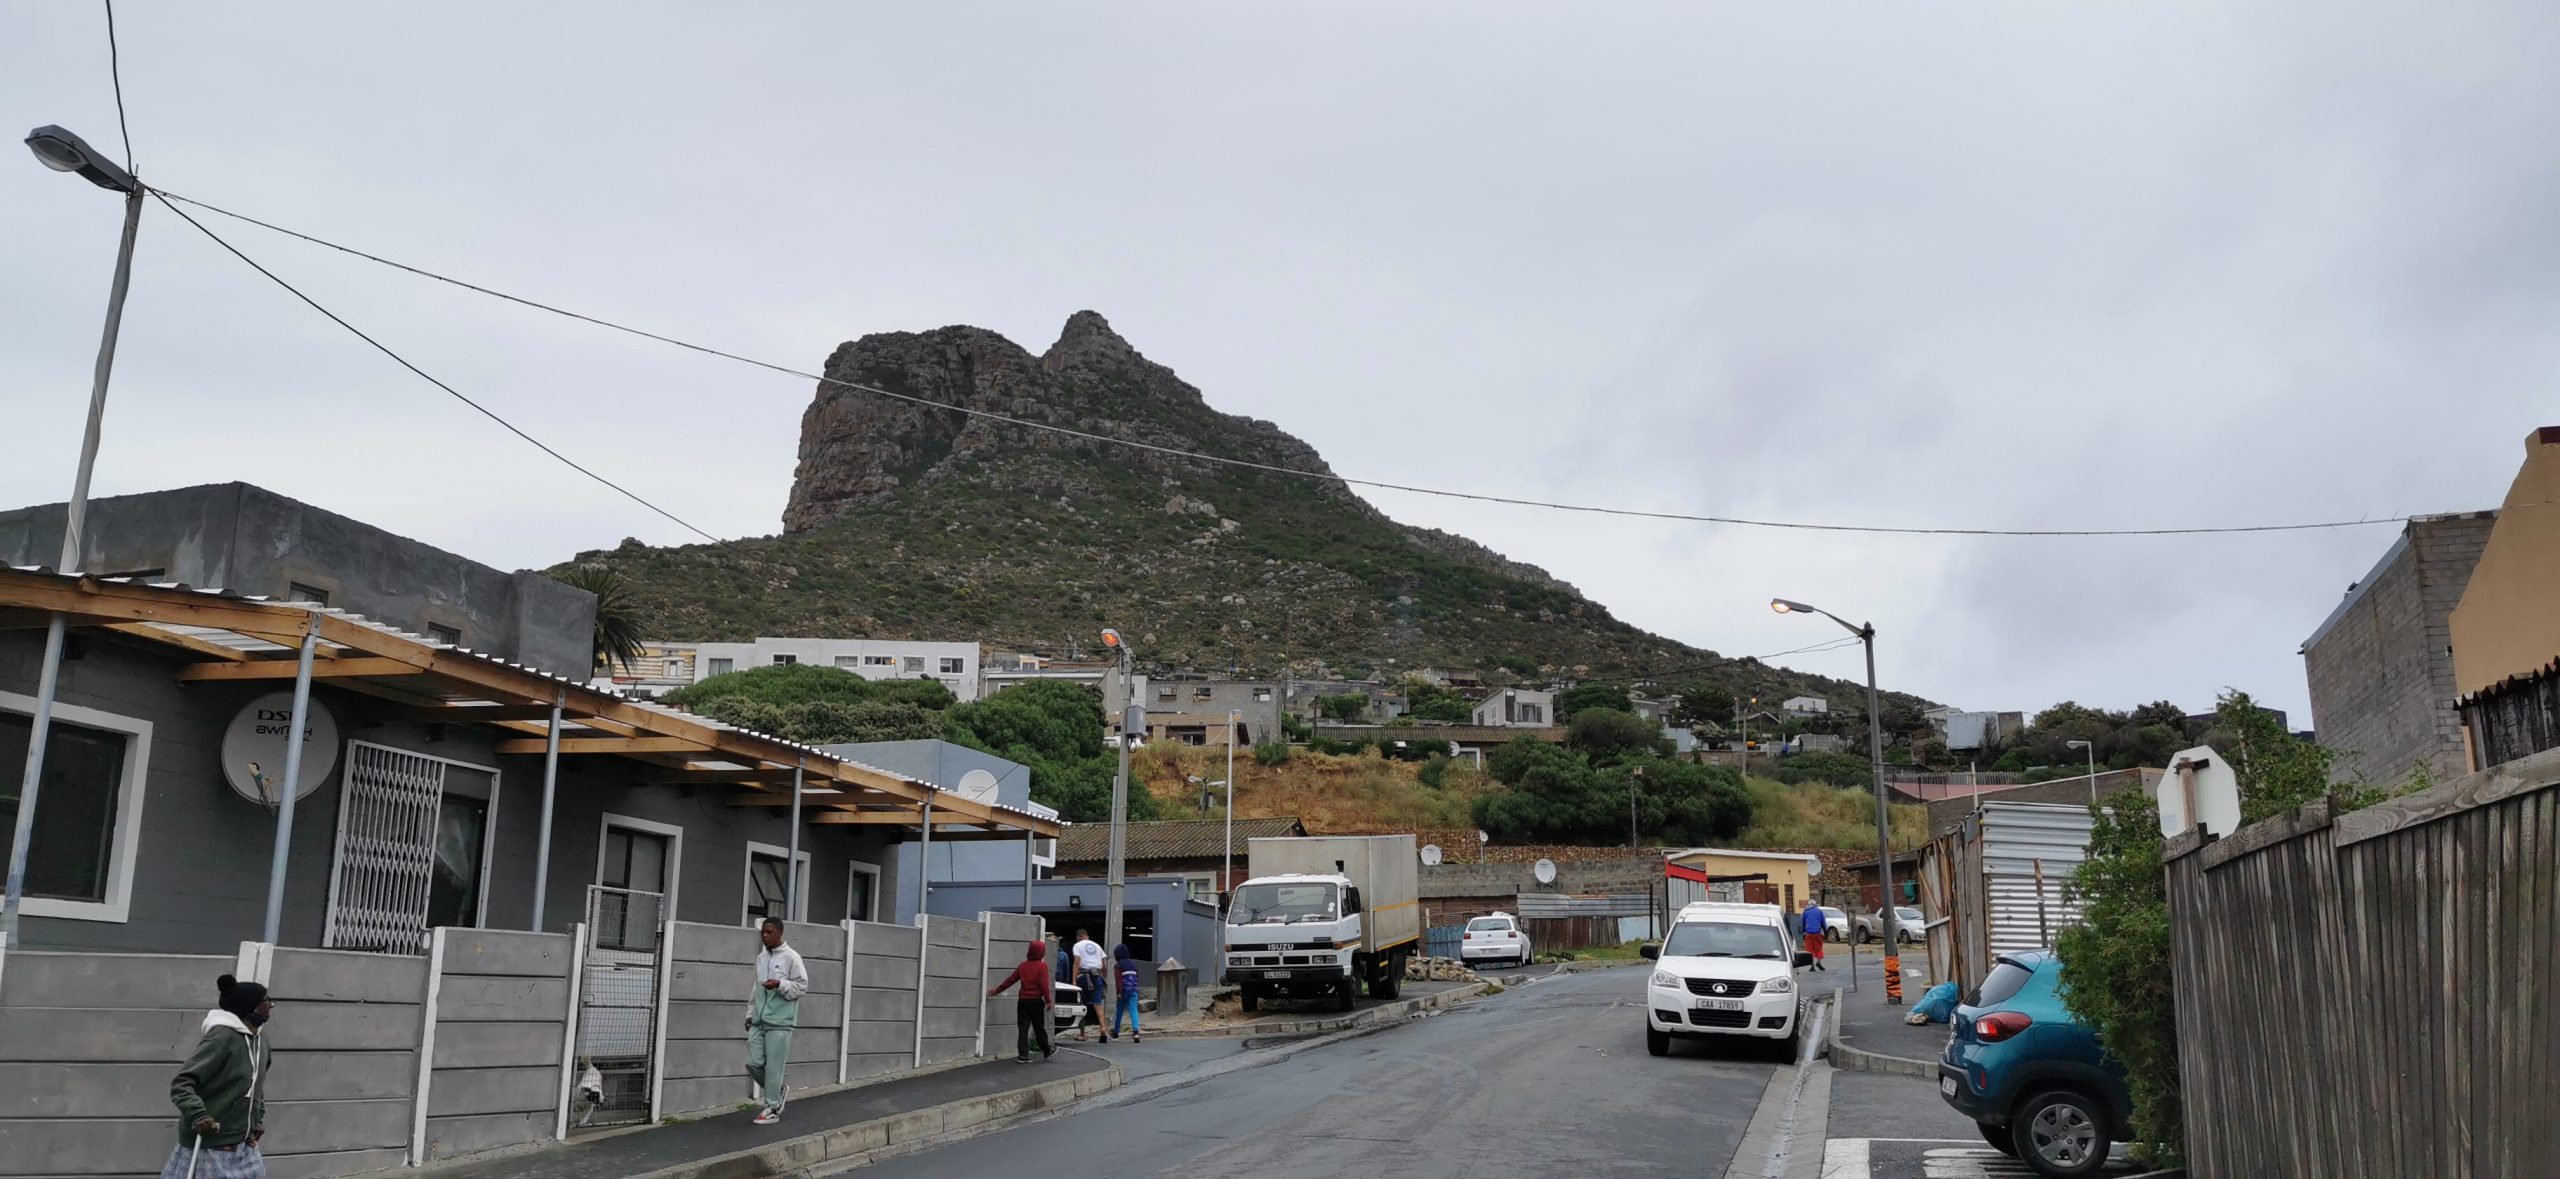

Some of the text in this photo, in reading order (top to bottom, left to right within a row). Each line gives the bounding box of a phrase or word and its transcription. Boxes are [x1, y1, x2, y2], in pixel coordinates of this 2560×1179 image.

[258, 710, 311, 722] DST
[1701, 1000, 1739, 1009] CAA 17859
